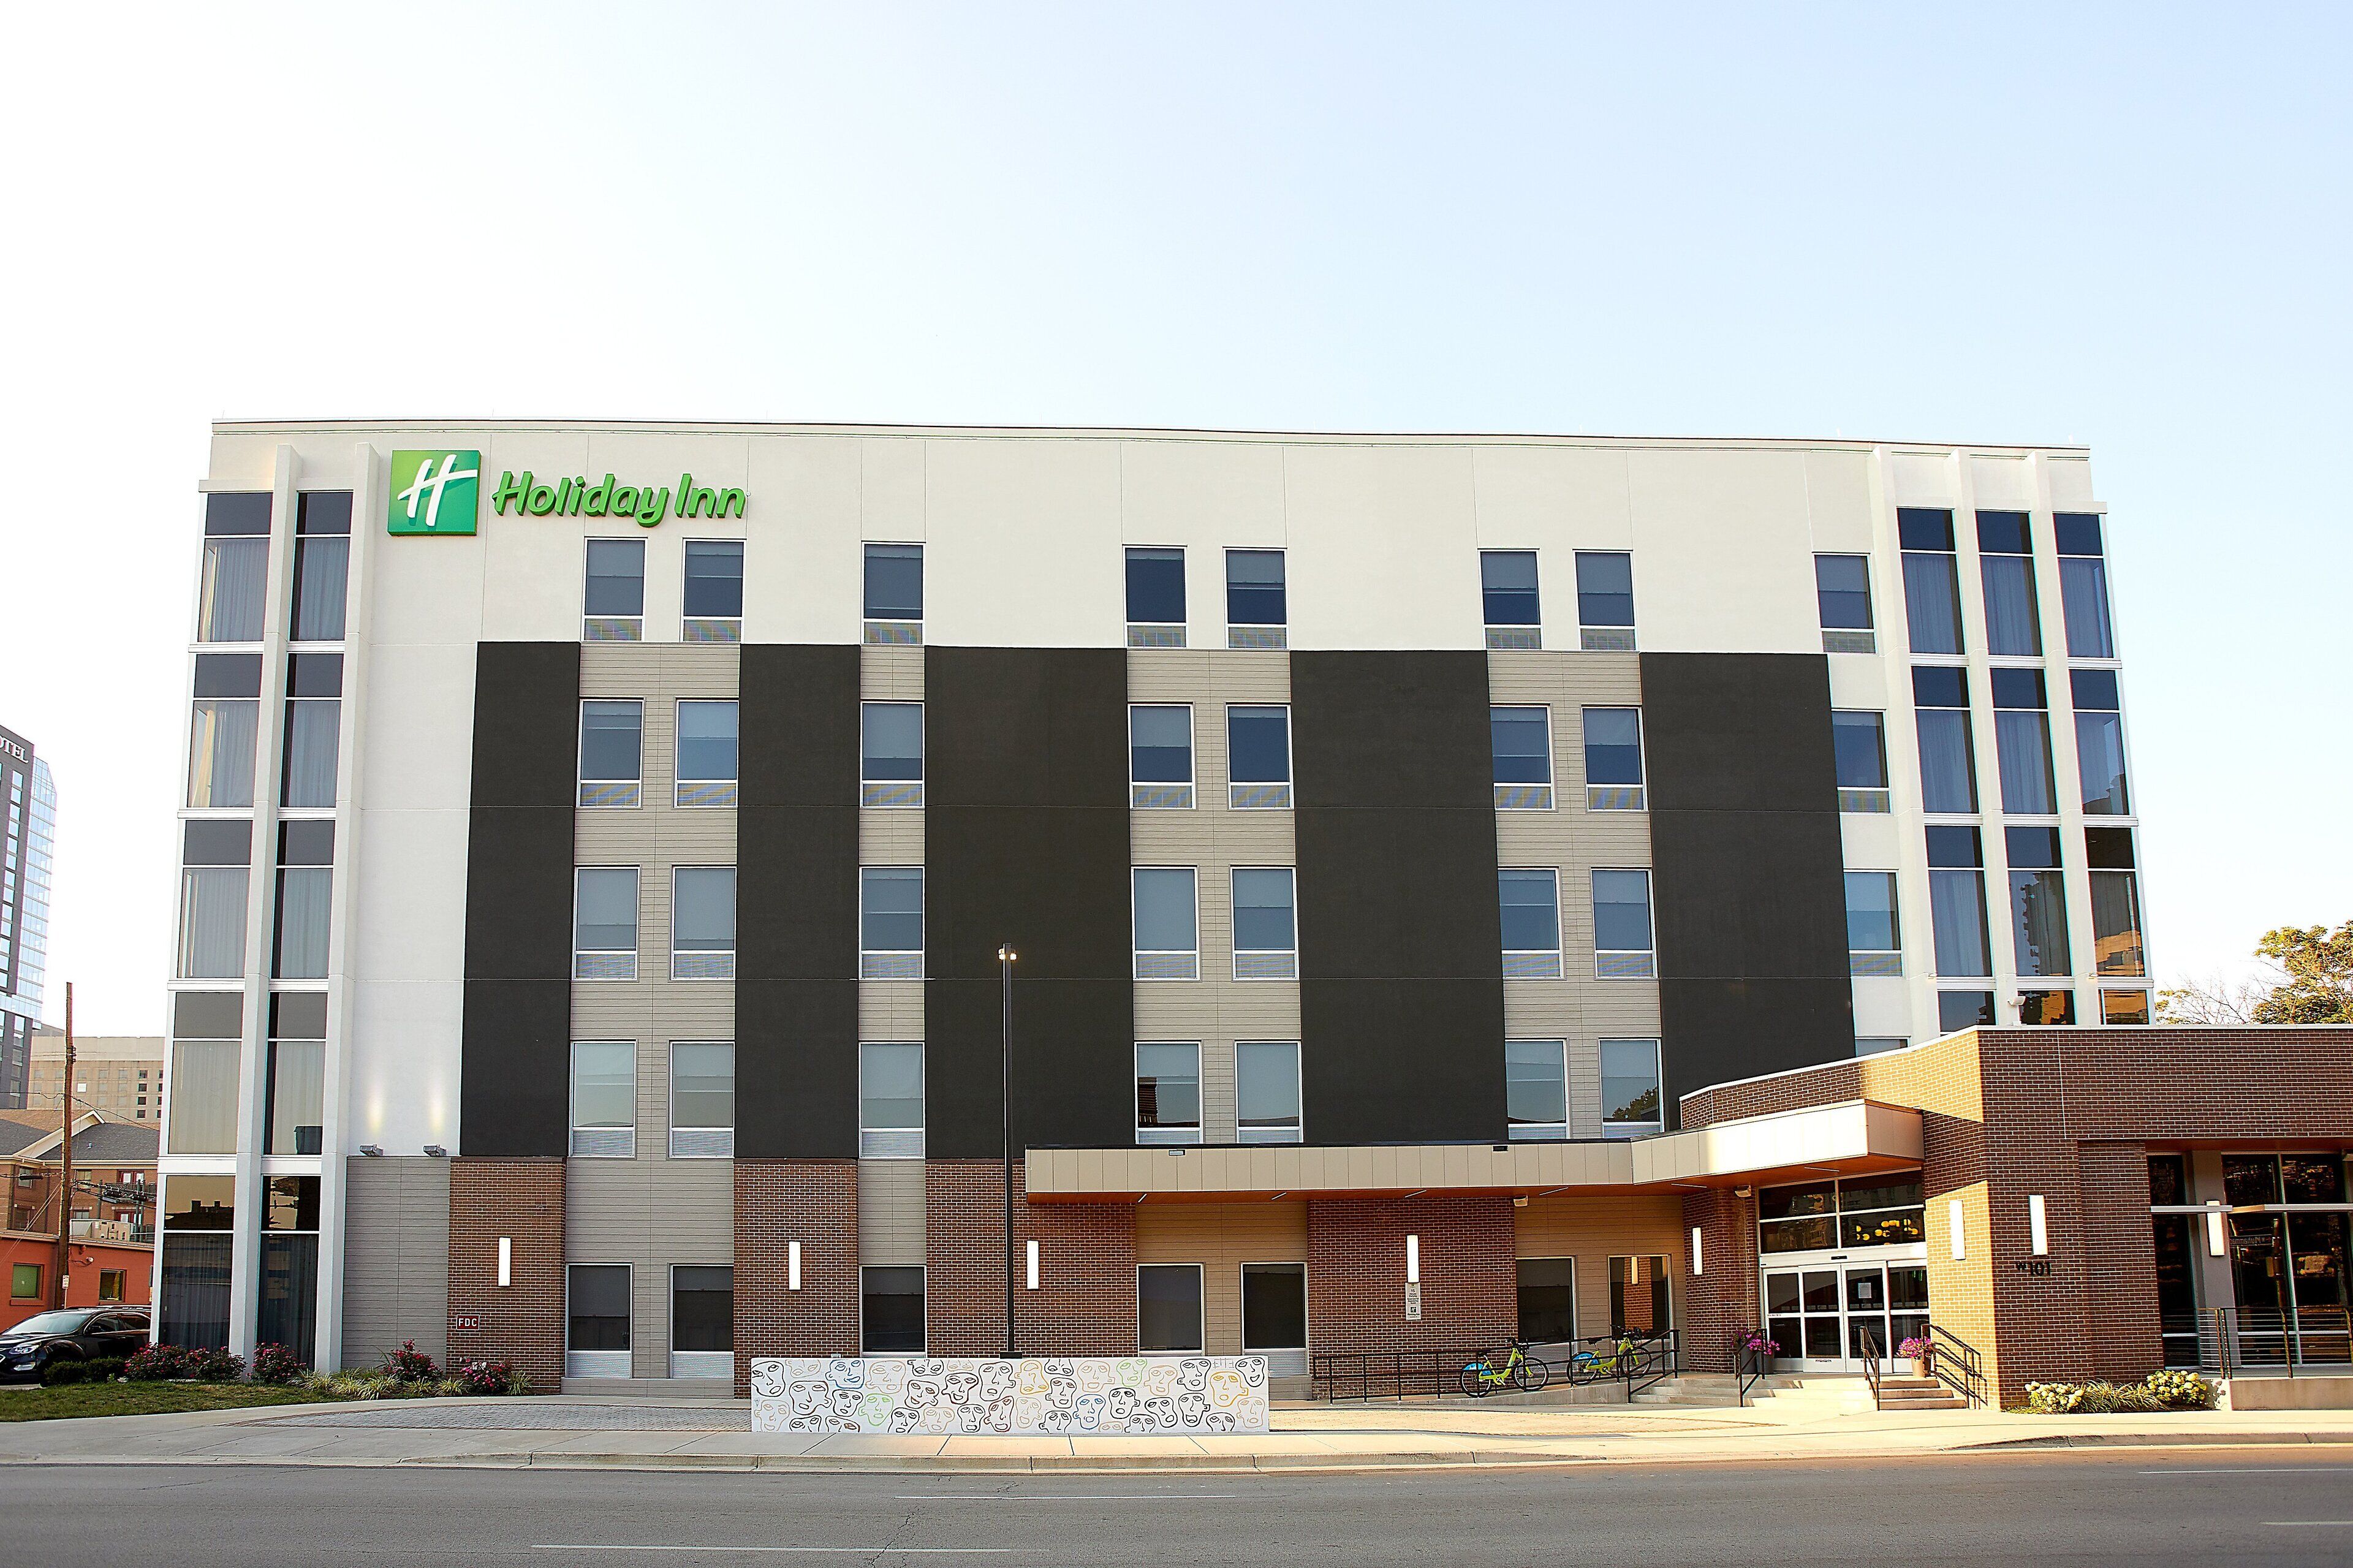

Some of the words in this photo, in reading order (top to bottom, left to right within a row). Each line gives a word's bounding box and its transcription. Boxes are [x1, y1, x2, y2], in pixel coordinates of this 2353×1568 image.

[491, 471, 669, 528] Holiday
[673, 473, 746, 519] Inn
[458, 1318, 477, 1327] FDC
